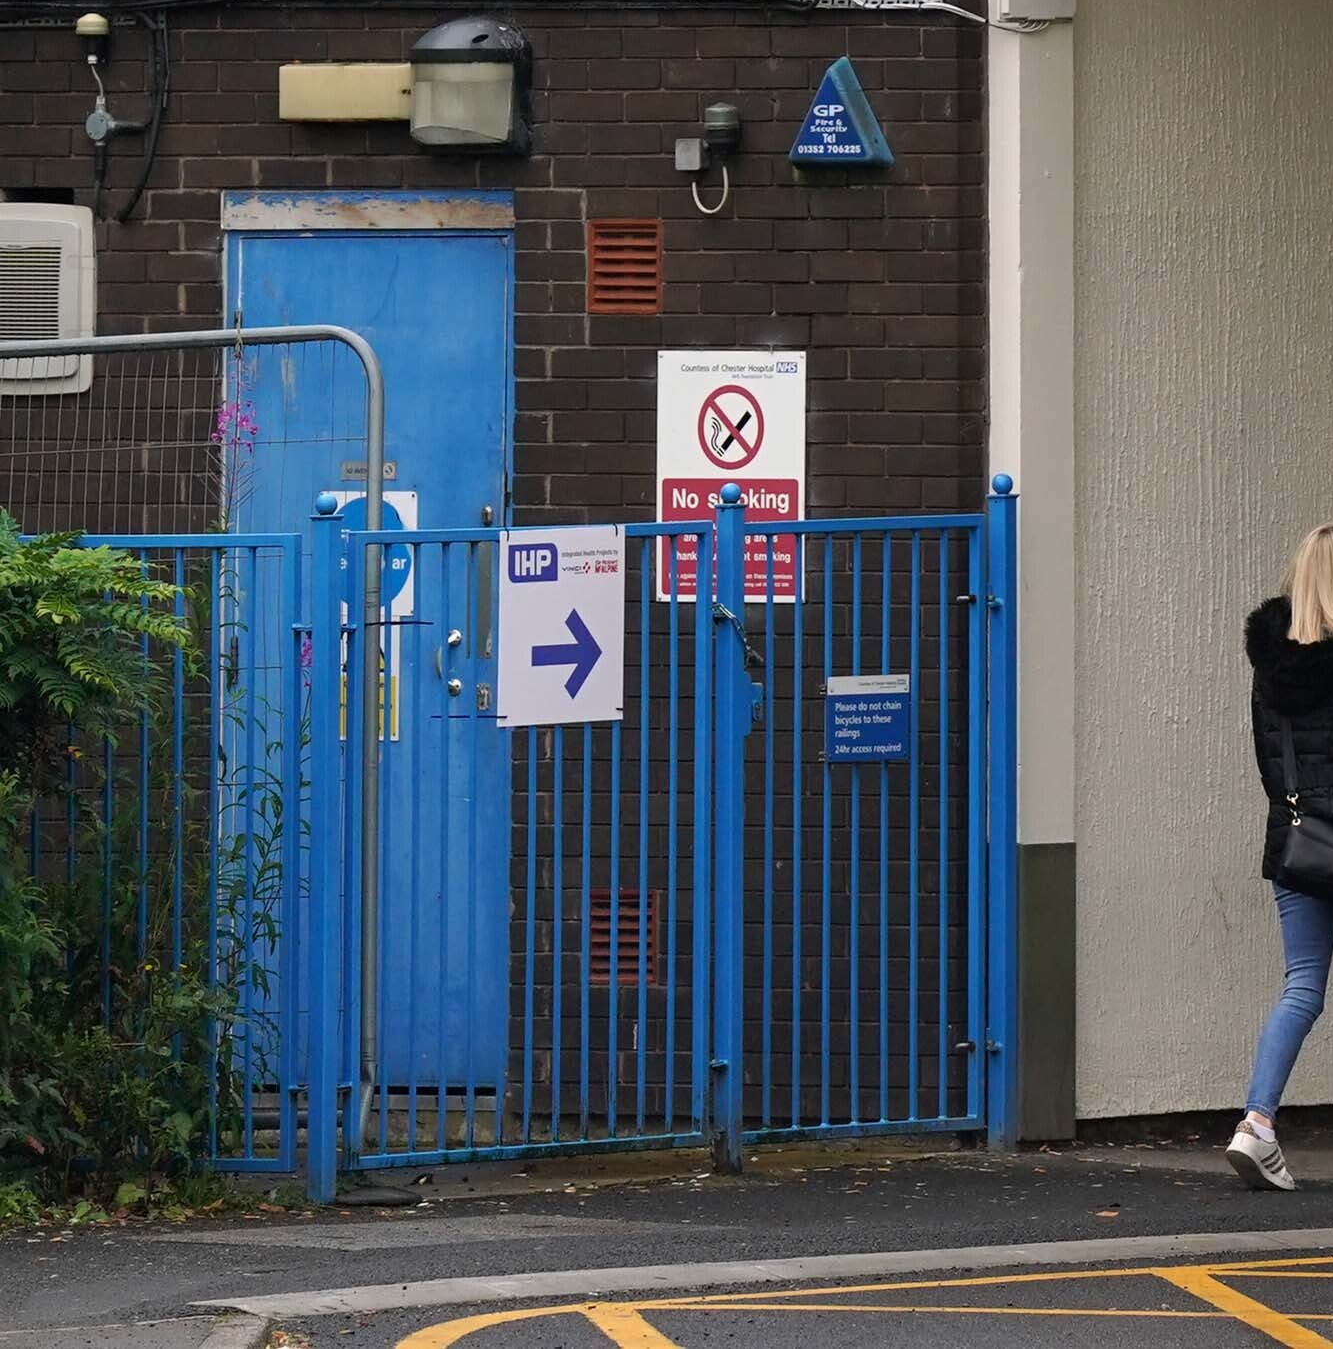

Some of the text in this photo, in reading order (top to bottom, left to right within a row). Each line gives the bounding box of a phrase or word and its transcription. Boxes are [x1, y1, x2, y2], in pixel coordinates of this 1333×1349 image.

[813, 104, 844, 117] GP
[815, 118, 843, 126] Fire &
[809, 125, 848, 133] Security
[822, 133, 836, 144] Tel
[798, 145, 861, 154] 01352 706225
[680, 362, 798, 373] Countess of Chester Hospital NHS
[672, 488, 790, 513] No soking
[753, 534, 778, 543] ares
[514, 549, 552, 576] IHP
[674, 551, 698, 560] hank
[753, 552, 791, 563] smking
[835, 701, 902, 711] Please do not chain
[835, 714, 892, 726] bicycles to these
[835, 728, 860, 739] railings
[835, 745, 850, 754] 24hr
[874, 742, 902, 755] required
